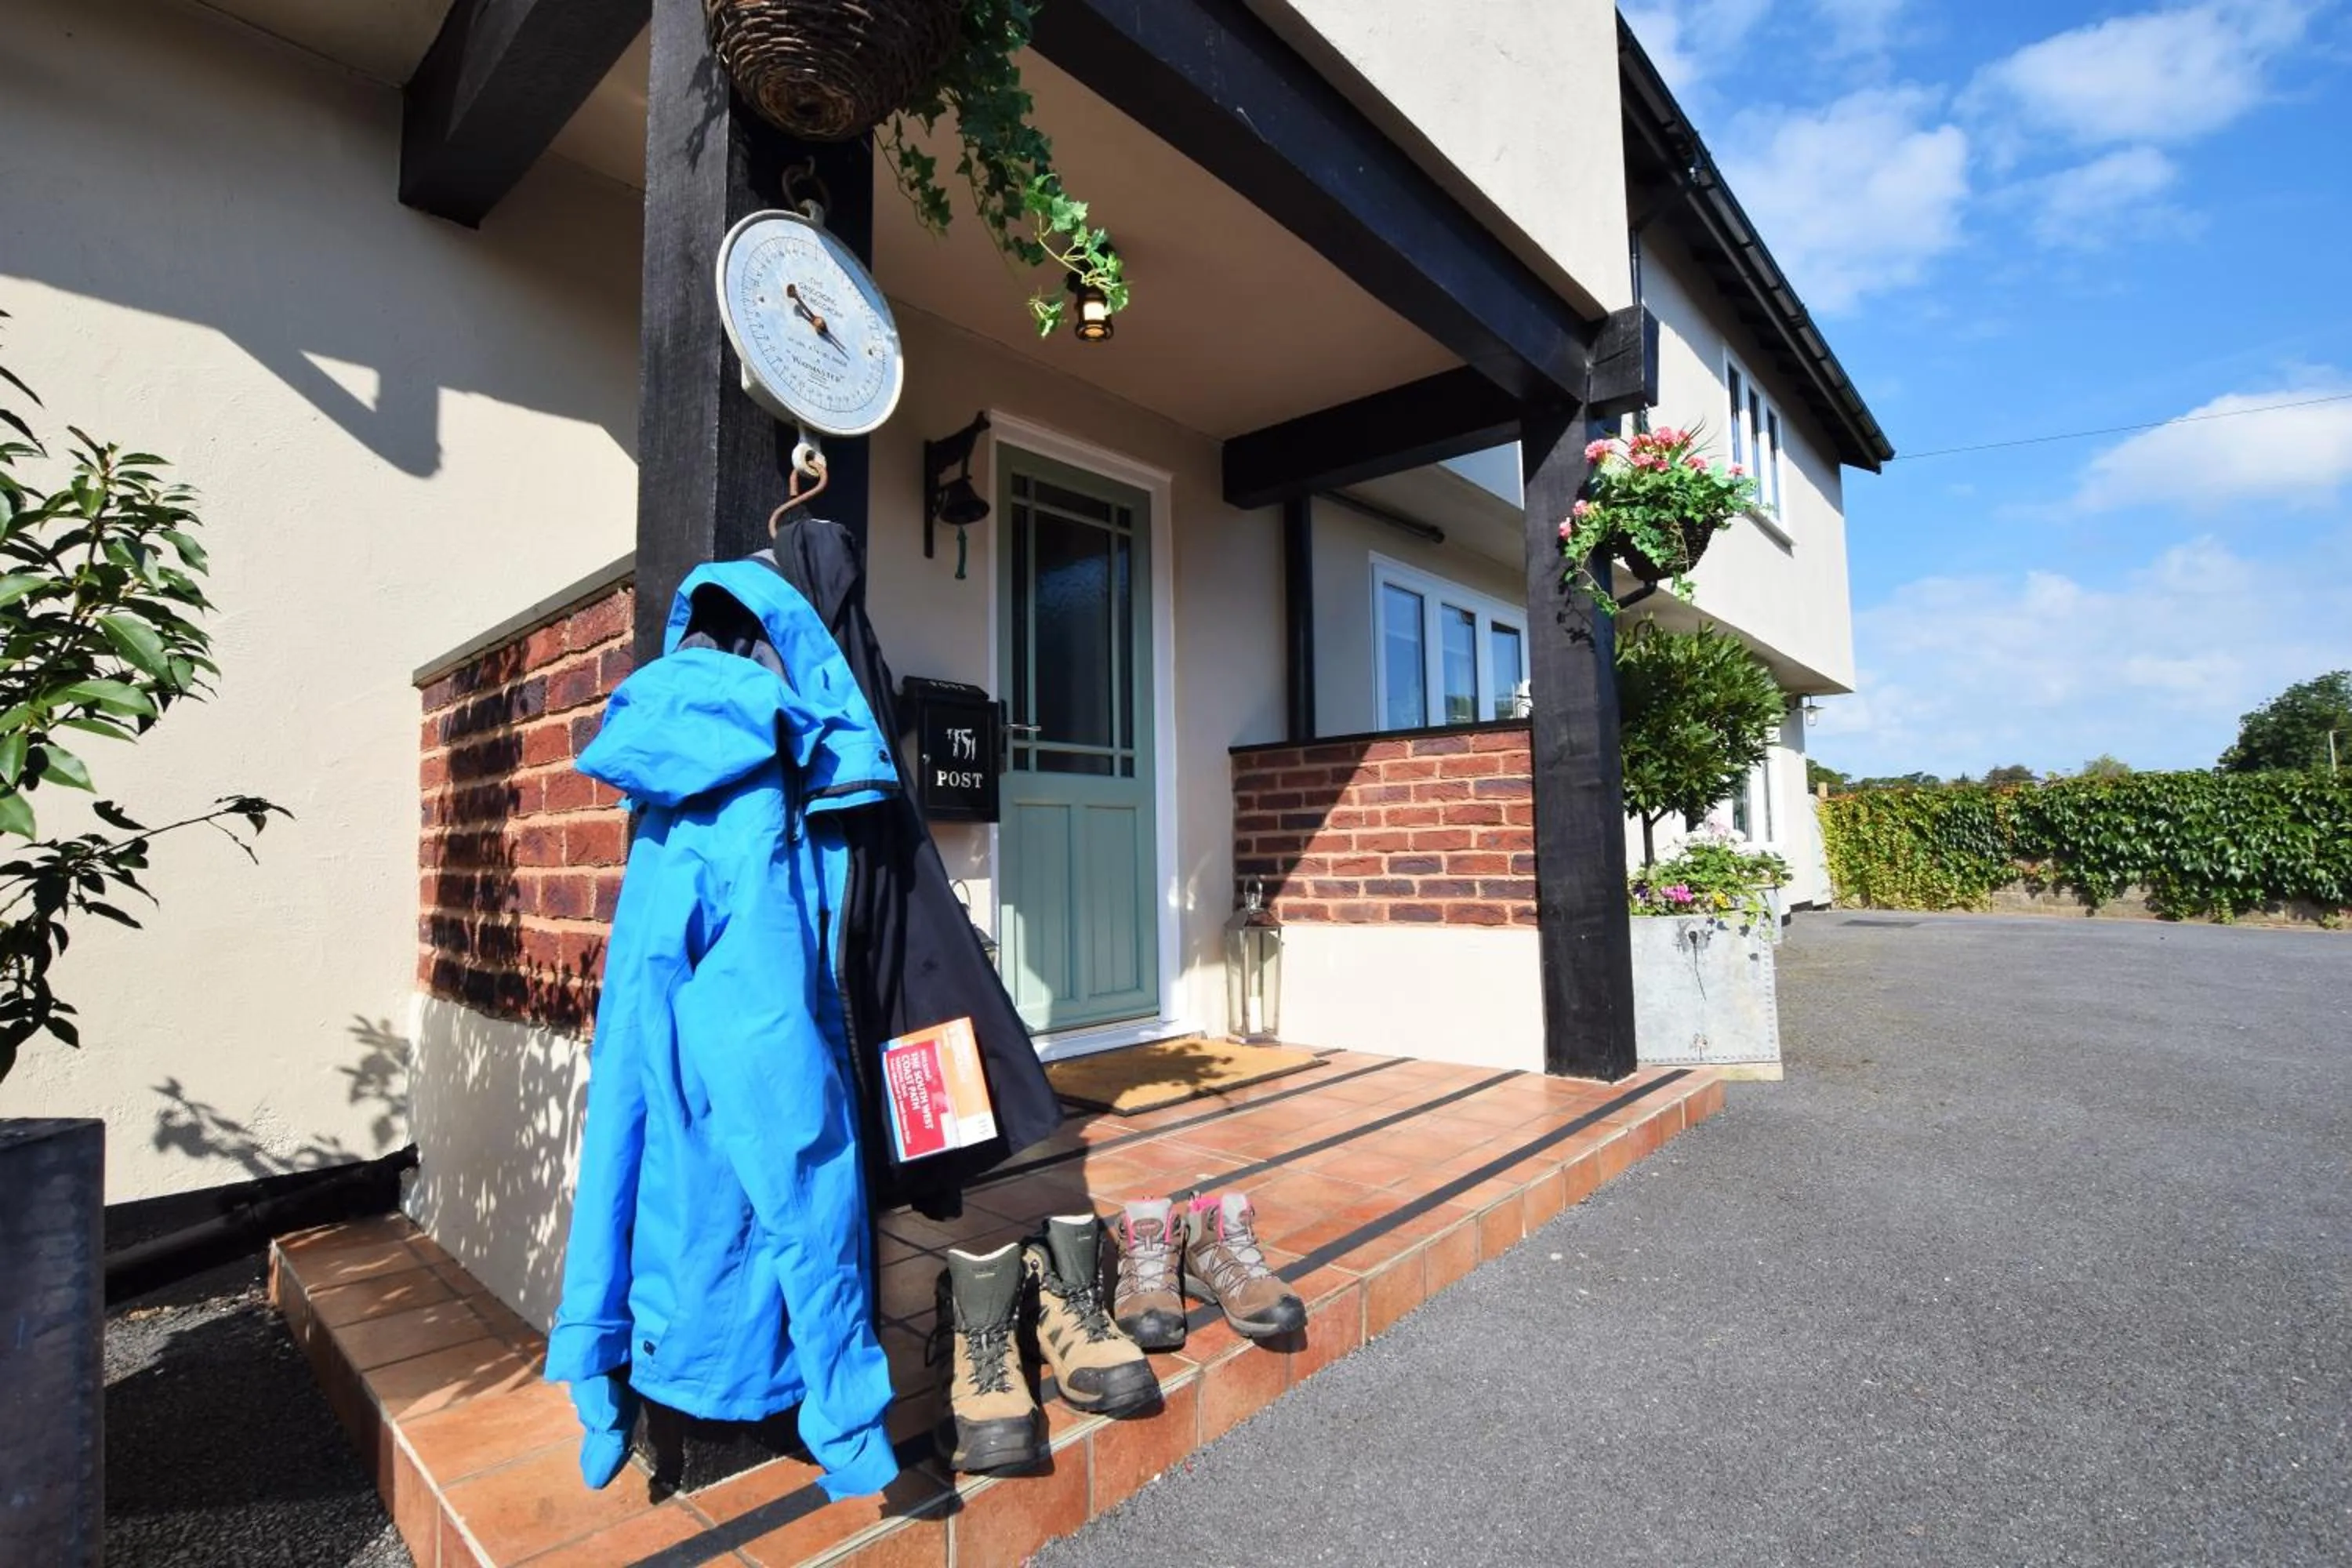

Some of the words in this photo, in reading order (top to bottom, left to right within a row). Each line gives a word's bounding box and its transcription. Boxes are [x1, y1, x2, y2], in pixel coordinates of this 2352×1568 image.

[936, 770, 983, 789] POST
[910, 1051, 921, 1069] THE
[902, 1054, 914, 1087] COAST
[909, 1087, 920, 1110] PATH
[915, 1069, 929, 1105] SOUTH
[921, 1105, 935, 1130] WEST
